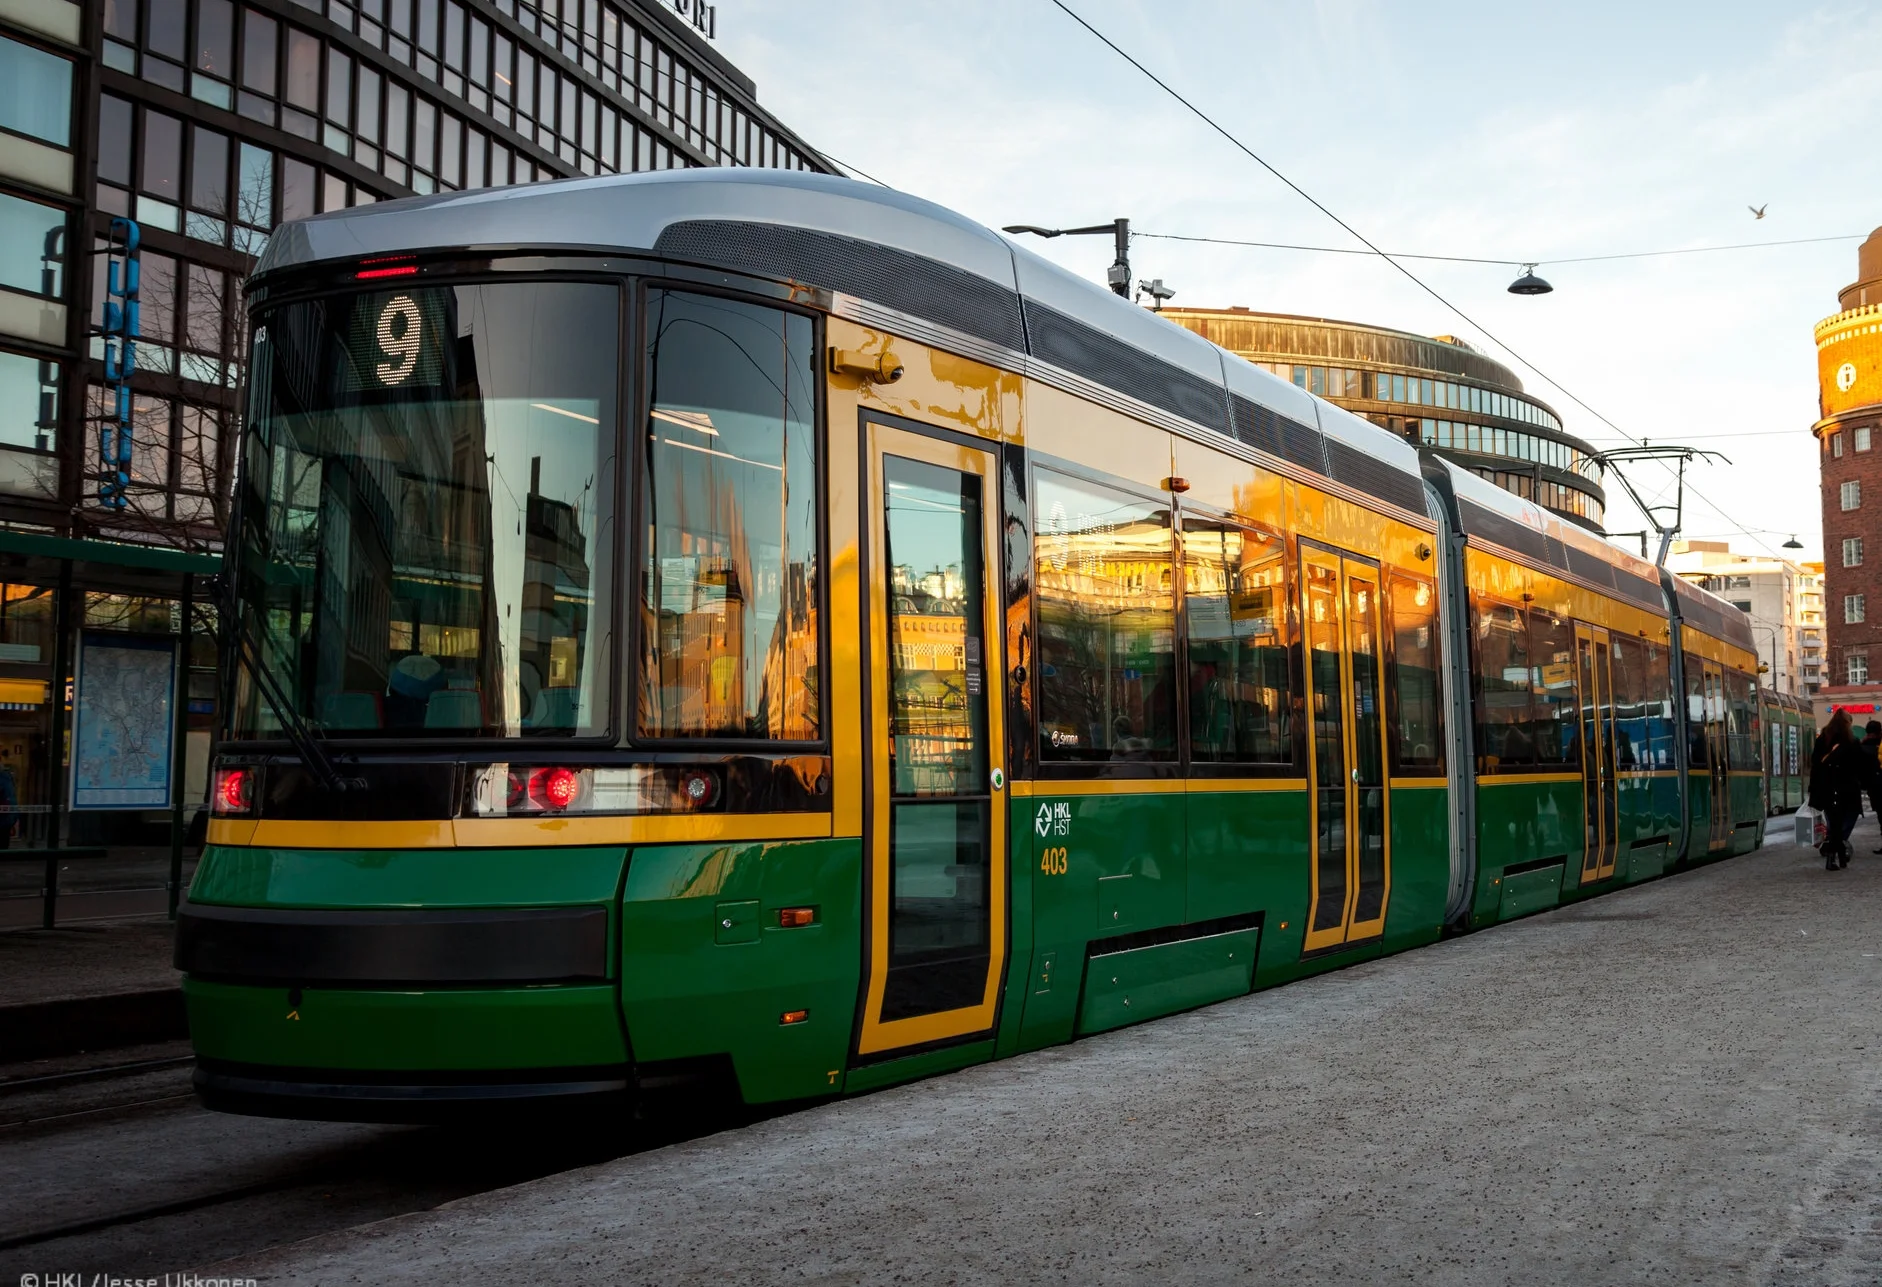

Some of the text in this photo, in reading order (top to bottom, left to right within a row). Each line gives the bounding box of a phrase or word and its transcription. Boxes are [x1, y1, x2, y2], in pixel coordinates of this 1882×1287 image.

[377, 296, 421, 387] 9
[1054, 803, 1071, 818] HKL
[1054, 819, 1071, 836] HST
[1041, 847, 1068, 875] 403
